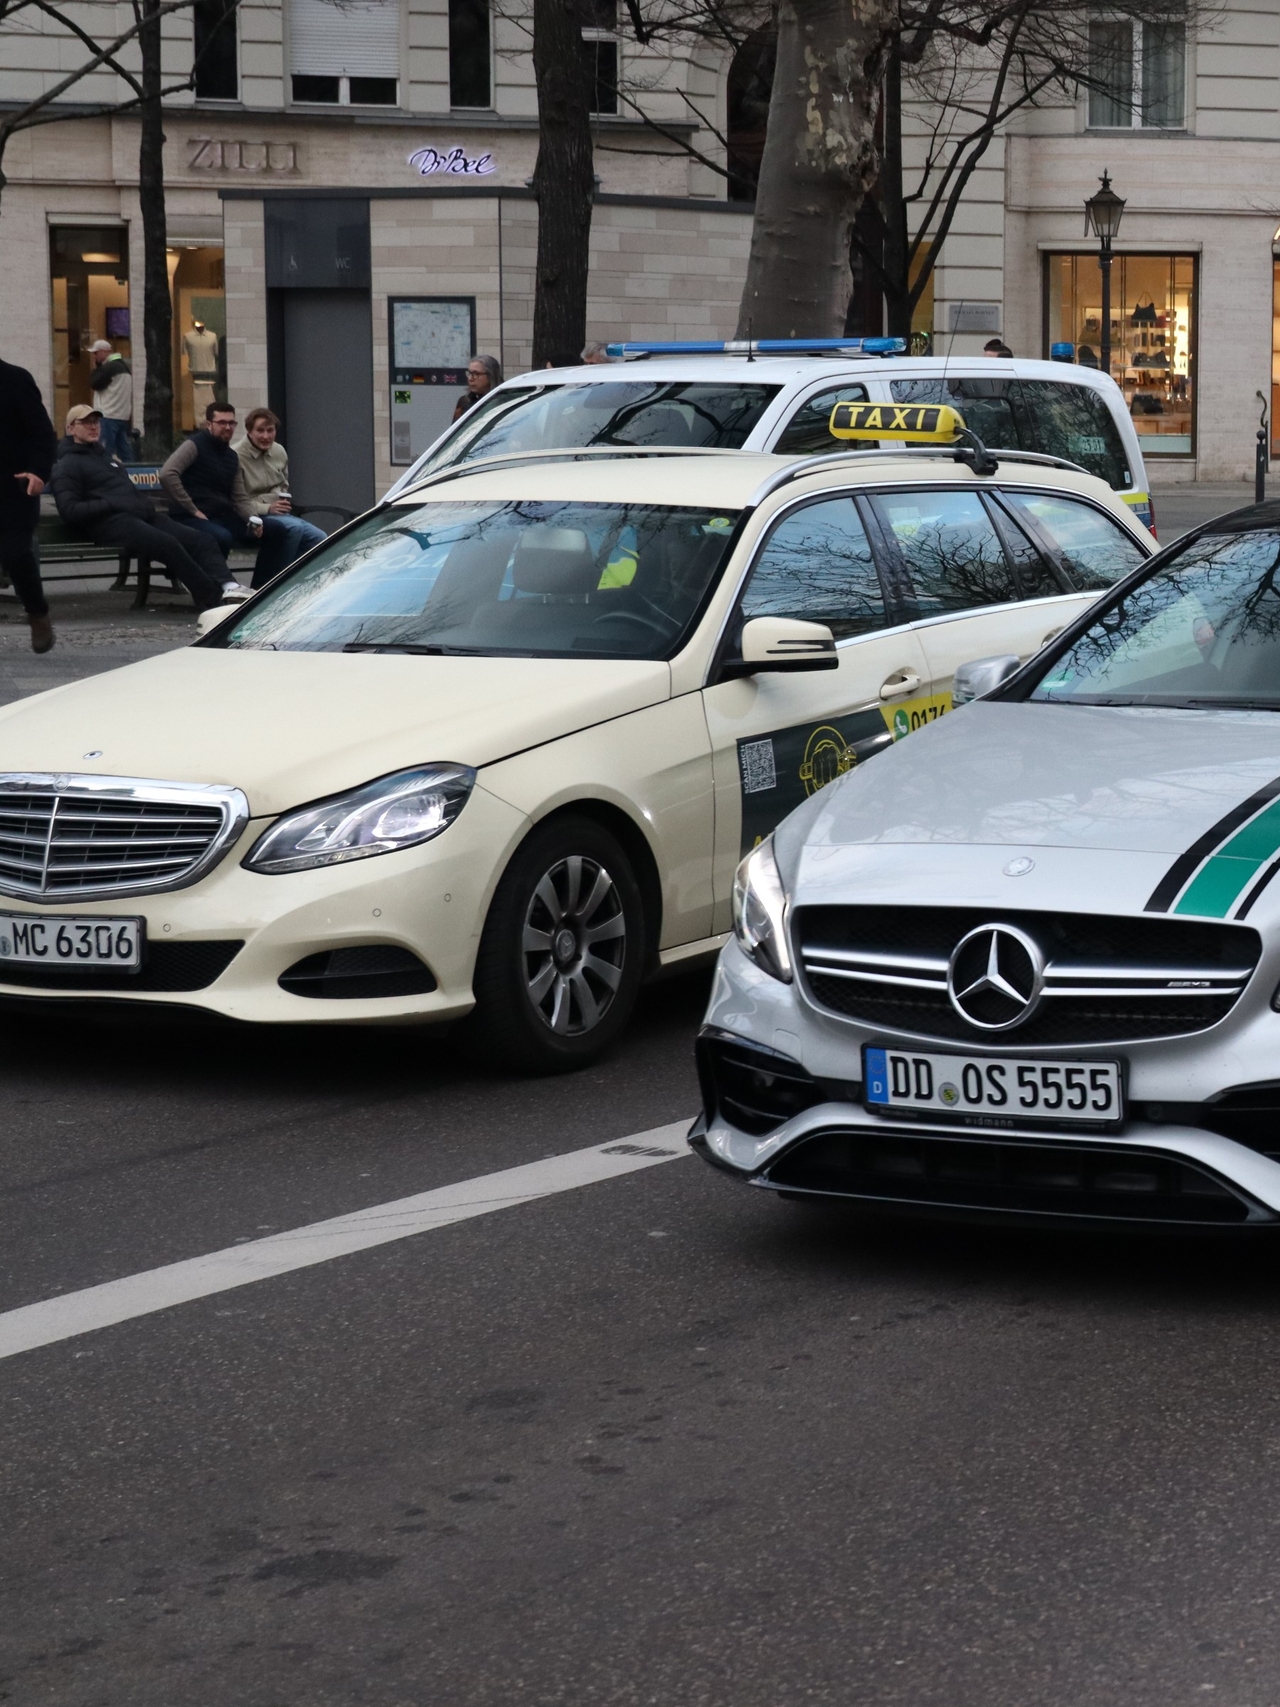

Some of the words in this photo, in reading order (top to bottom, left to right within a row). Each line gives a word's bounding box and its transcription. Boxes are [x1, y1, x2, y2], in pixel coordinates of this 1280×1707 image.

[187, 138, 300, 171] ZILLI
[335, 257, 350, 269] WC
[848, 406, 926, 430] TAXI
[740, 744, 748, 769] MICH
[12, 922, 49, 956] MC
[56, 925, 133, 959] 6306
[872, 1081, 883, 1094] D
[890, 1056, 934, 1100] DD
[962, 1063, 1008, 1106] OS
[1017, 1066, 1113, 1111] 5555
[964, 1116, 1014, 1128] widmann
